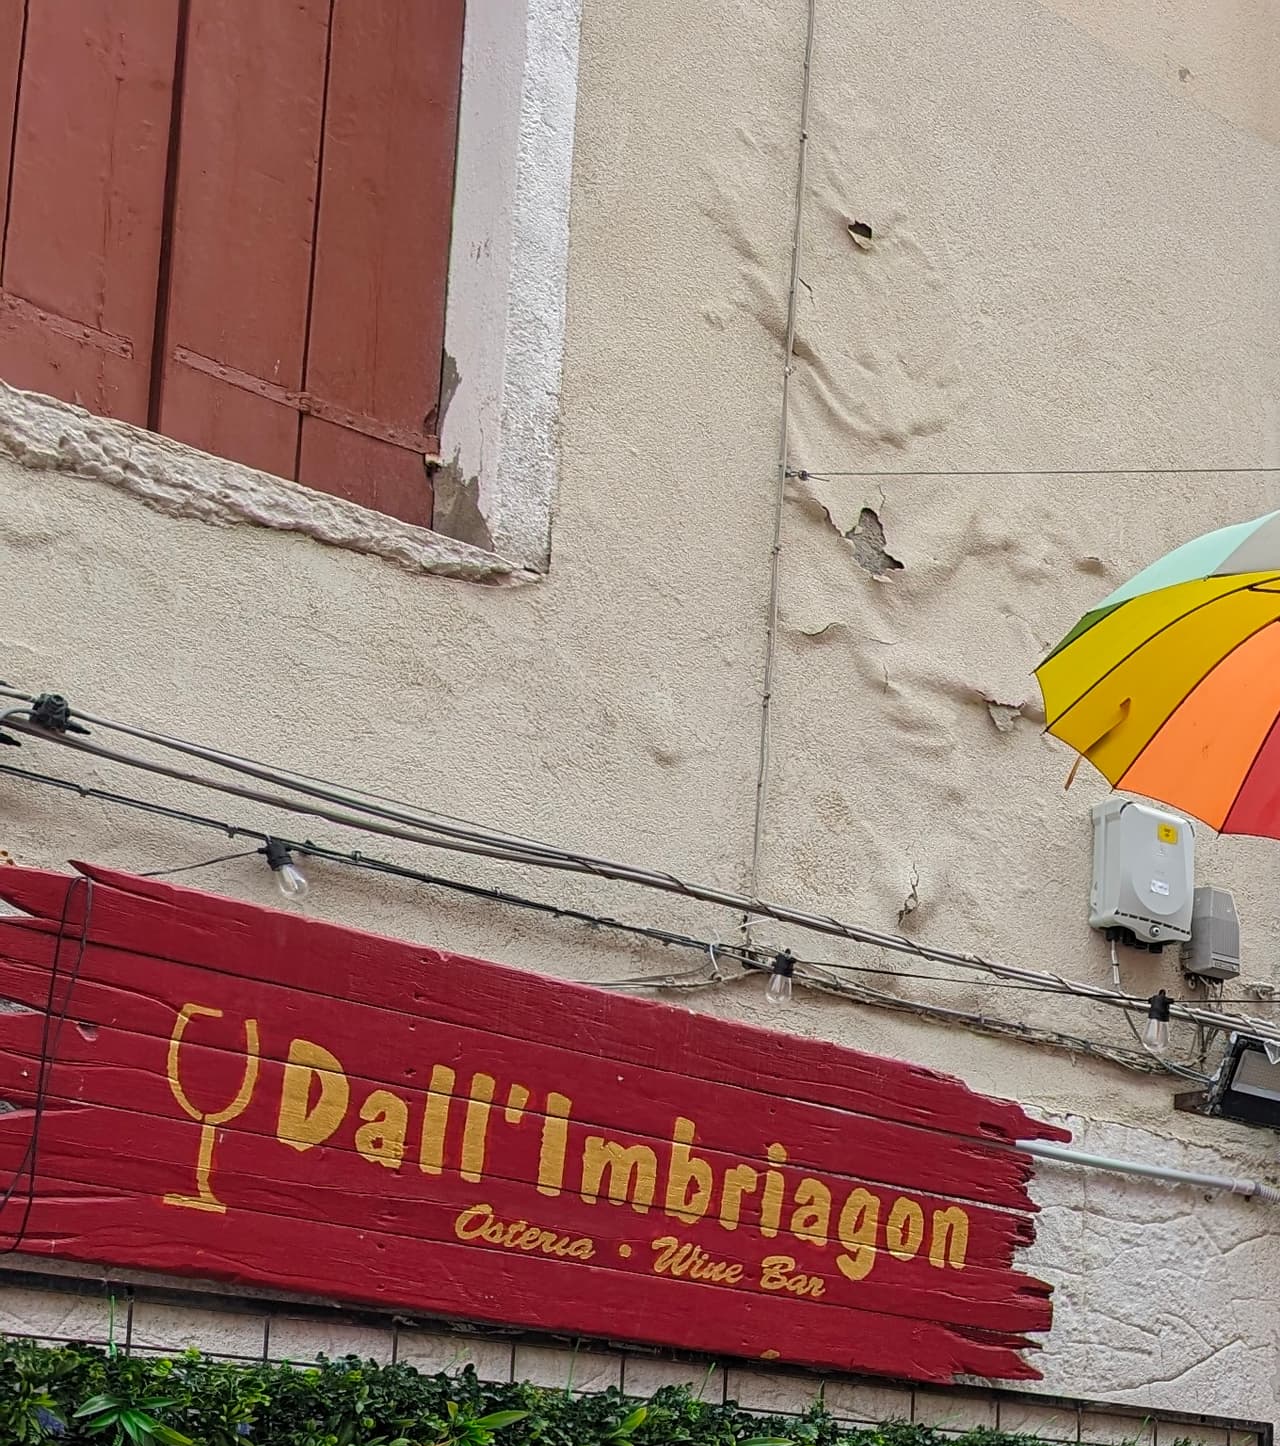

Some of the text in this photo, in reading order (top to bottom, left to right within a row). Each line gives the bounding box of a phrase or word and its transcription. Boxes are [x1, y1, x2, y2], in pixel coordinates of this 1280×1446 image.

[276, 1038, 970, 1281] Dall'Imbriagon
[454, 1203, 826, 1297] Osteria Wine Bar
